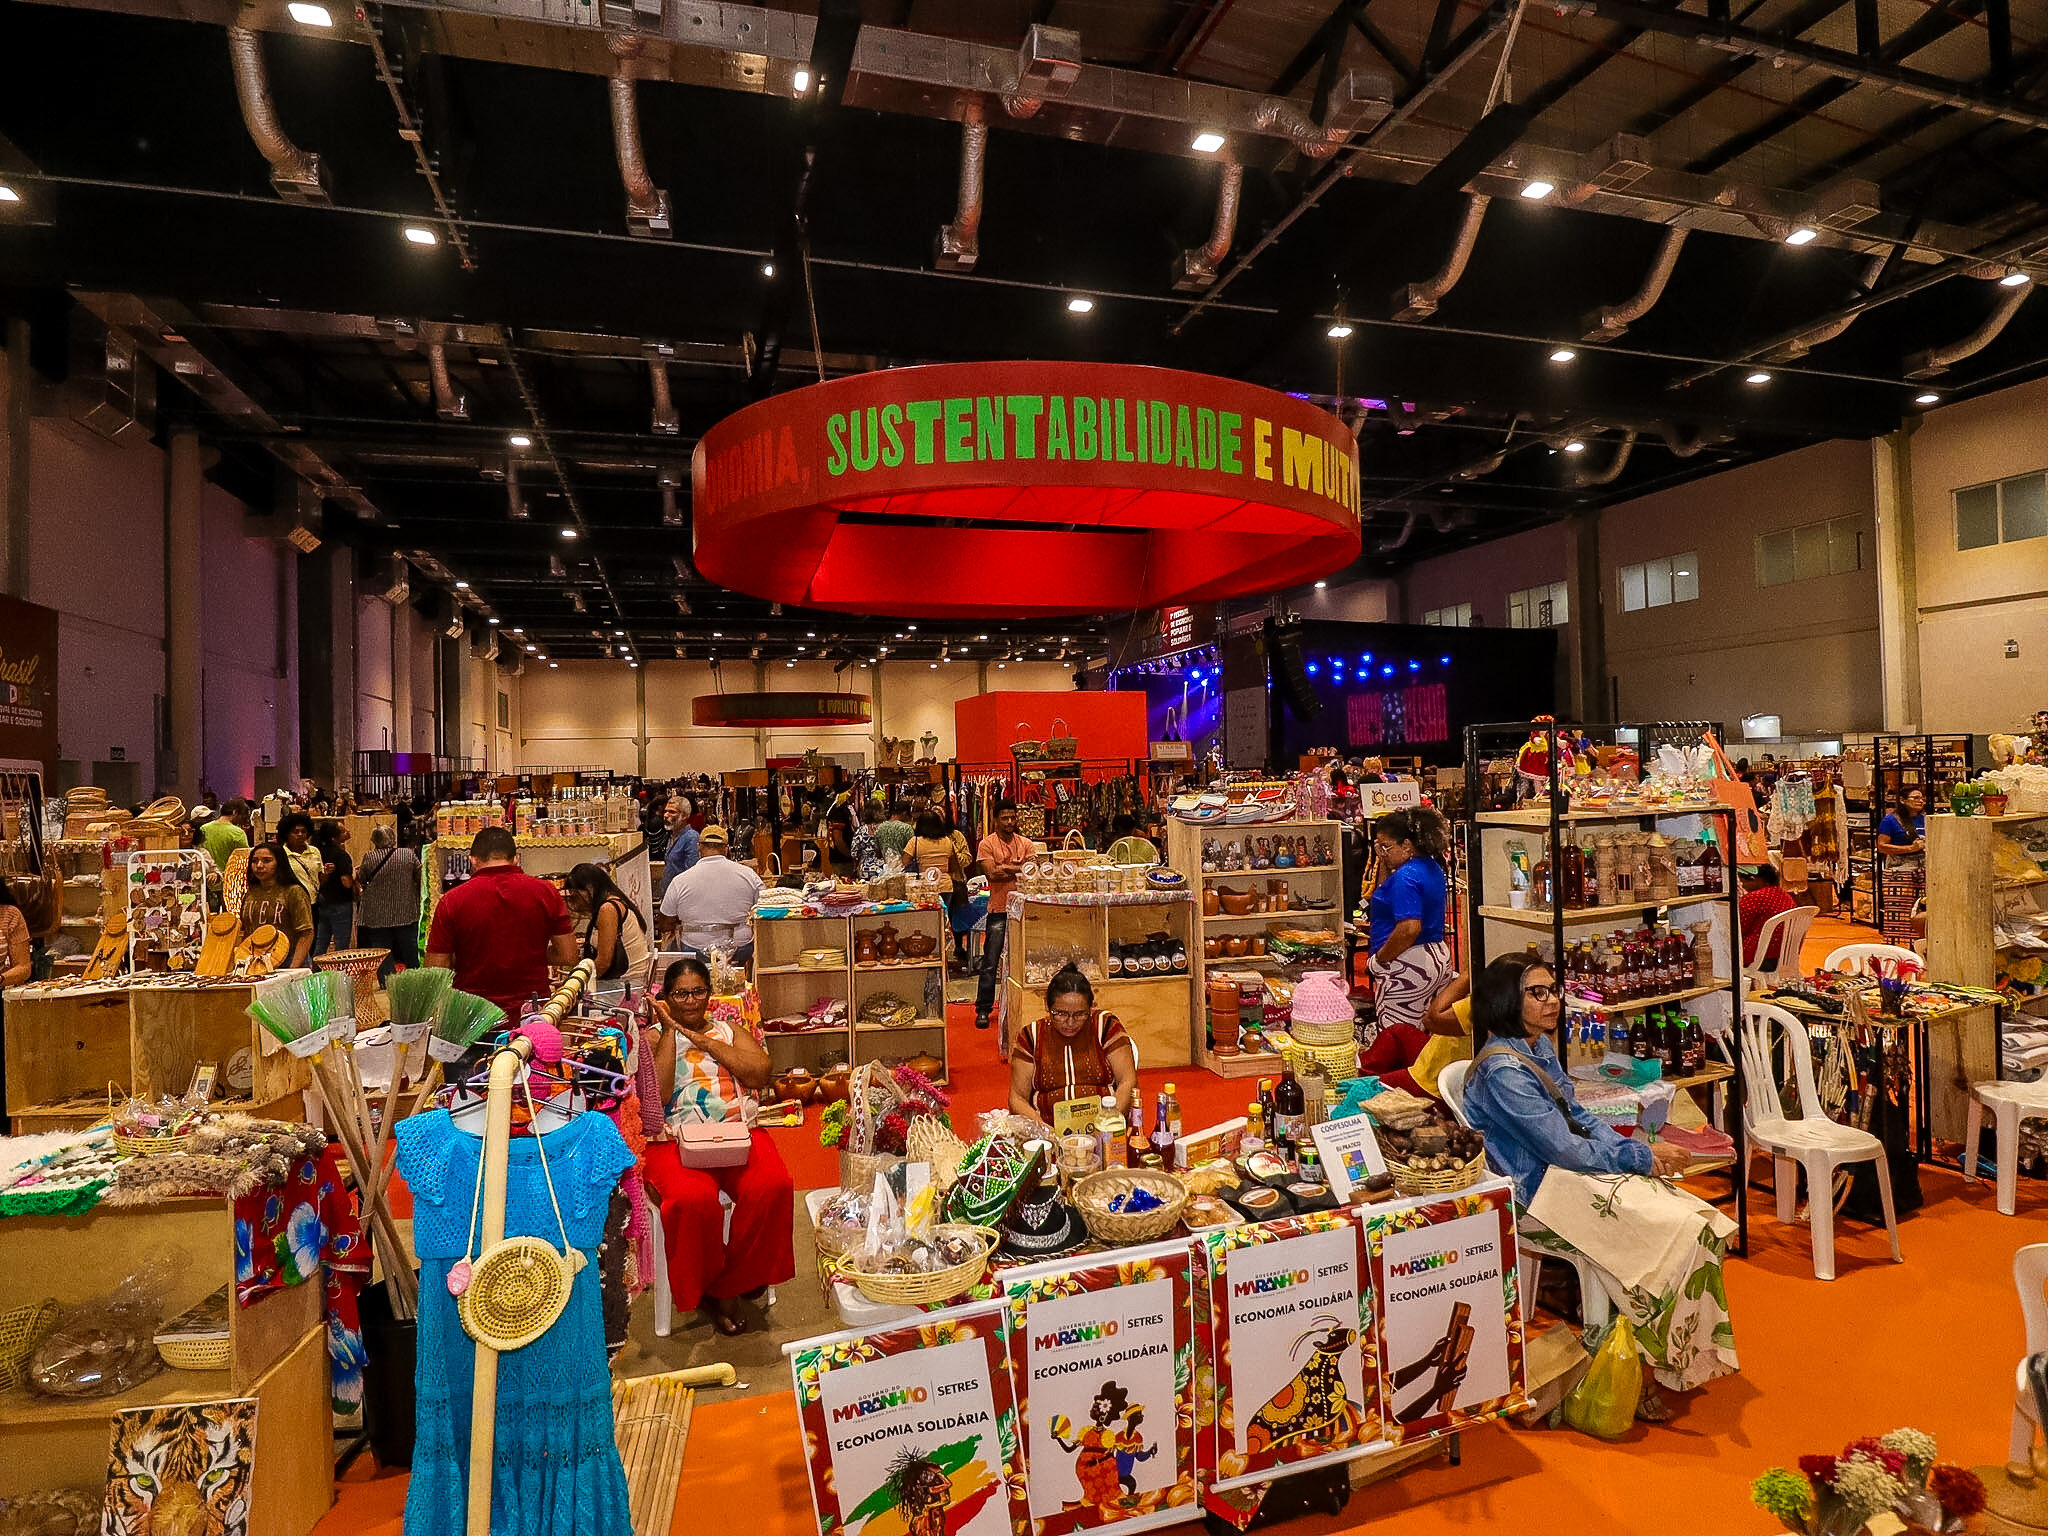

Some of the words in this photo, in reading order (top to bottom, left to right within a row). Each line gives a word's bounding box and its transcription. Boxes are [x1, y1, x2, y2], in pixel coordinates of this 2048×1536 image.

[826, 394, 1243, 477] SUSTENTABILIDADE
[1253, 417, 1274, 482] E
[1170, 624, 1189, 637] POPULAR
[1385, 790, 1412, 802] cesol
[1465, 1242, 1494, 1257] SETRES
[1317, 1262, 1349, 1278] SETRES
[1389, 1282, 1447, 1303] ECONOMIA
[1449, 1270, 1499, 1290] SOLIDÁRIA
[1234, 1303, 1296, 1325] ECONOMIA
[1298, 1288, 1354, 1311] SOLIDÁRIA
[1127, 1313, 1164, 1329] SETRES
[1034, 1357, 1103, 1380] ECONOMIA
[1106, 1343, 1169, 1365] SOLIDÁRIA
[937, 1379, 979, 1397] SETRES
[836, 1423, 914, 1452] ECONOMIA
[917, 1410, 990, 1433] SOLIDÁRIA
